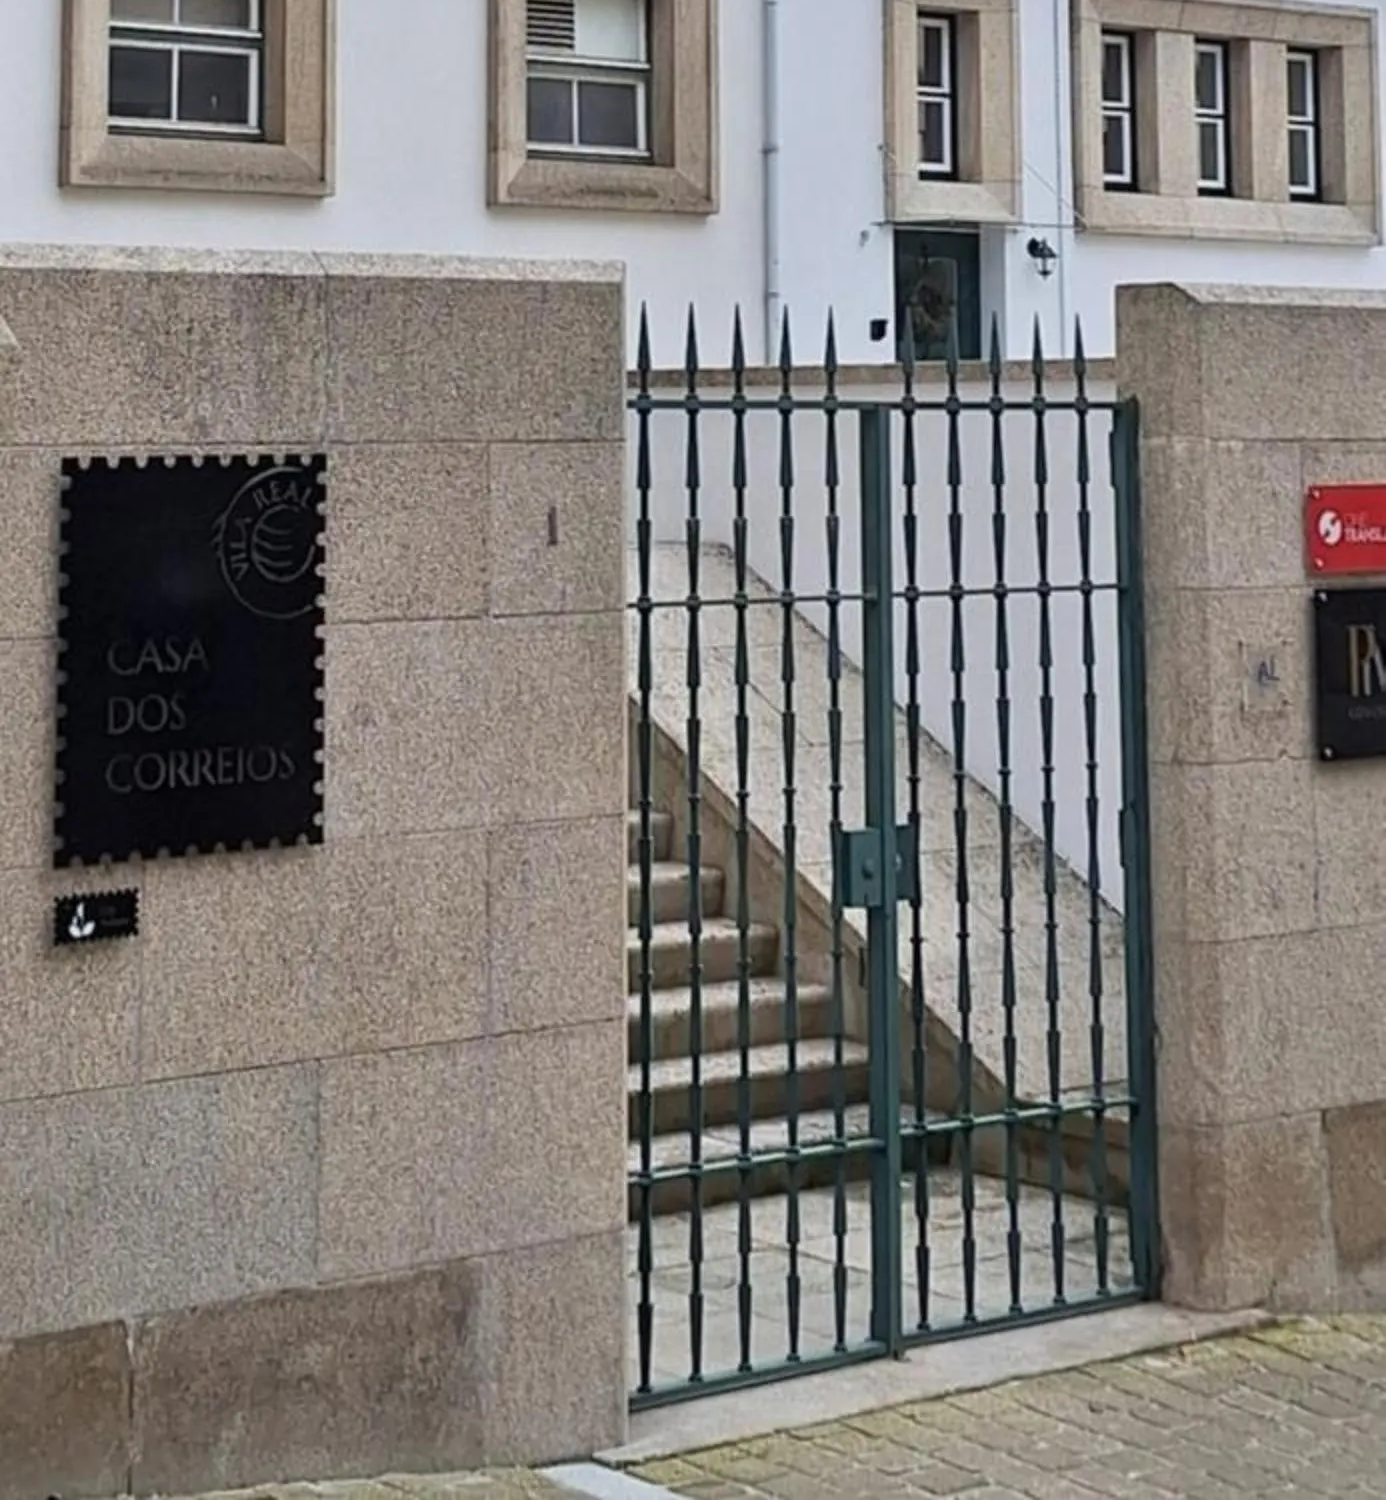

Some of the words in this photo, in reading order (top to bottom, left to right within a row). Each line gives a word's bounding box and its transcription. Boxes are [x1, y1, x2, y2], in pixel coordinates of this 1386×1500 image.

[229, 518, 252, 581] VILA
[252, 480, 312, 509] REAL
[107, 636, 209, 675] CASA
[107, 691, 186, 734] DOS
[105, 743, 295, 793] CORREIOS
